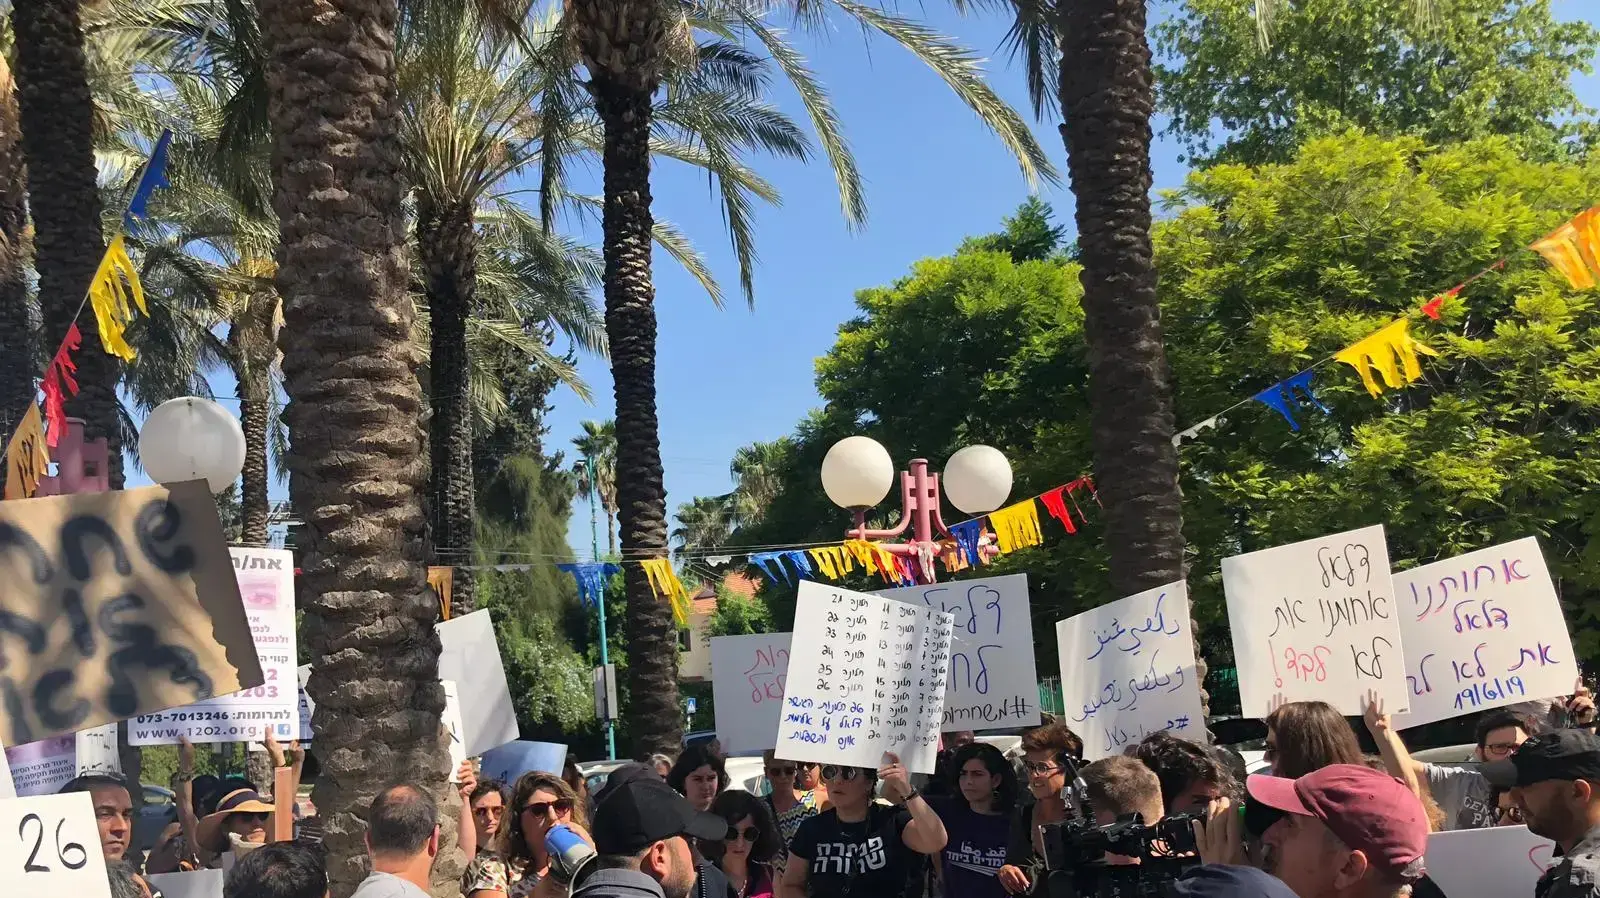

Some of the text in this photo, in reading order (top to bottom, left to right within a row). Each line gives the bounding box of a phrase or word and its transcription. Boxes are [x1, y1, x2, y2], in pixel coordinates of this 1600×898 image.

[1318, 544, 1370, 588] דלאל
[1410, 559, 1531, 622] אחותנו
[827, 611, 839, 623] 22
[924, 585, 1001, 634] דלא
[1269, 590, 1389, 638] אחותנו את
[1454, 599, 1509, 633] דלאל
[880, 620, 889, 630] 12
[825, 627, 837, 639] 23
[821, 645, 833, 659] 24
[878, 639, 888, 650] 13
[1351, 636, 1392, 679] לא
[818, 664, 833, 675] 25
[946, 645, 1003, 695] לח
[1406, 641, 1560, 695] את לא לב
[749, 671, 787, 704] לאל
[816, 678, 831, 691] 26
[876, 676, 885, 686] 15
[874, 689, 885, 699] 16
[1454, 676, 1524, 710] 19/6/19
[850, 702, 864, 713] 26
[137, 712, 229, 724] 073-7013246
[136, 724, 274, 739] www.1202.org.l
[1472, 813, 1491, 828] PA
[19, 813, 87, 873] 26
[946, 851, 1005, 866] ומדים ביחד
